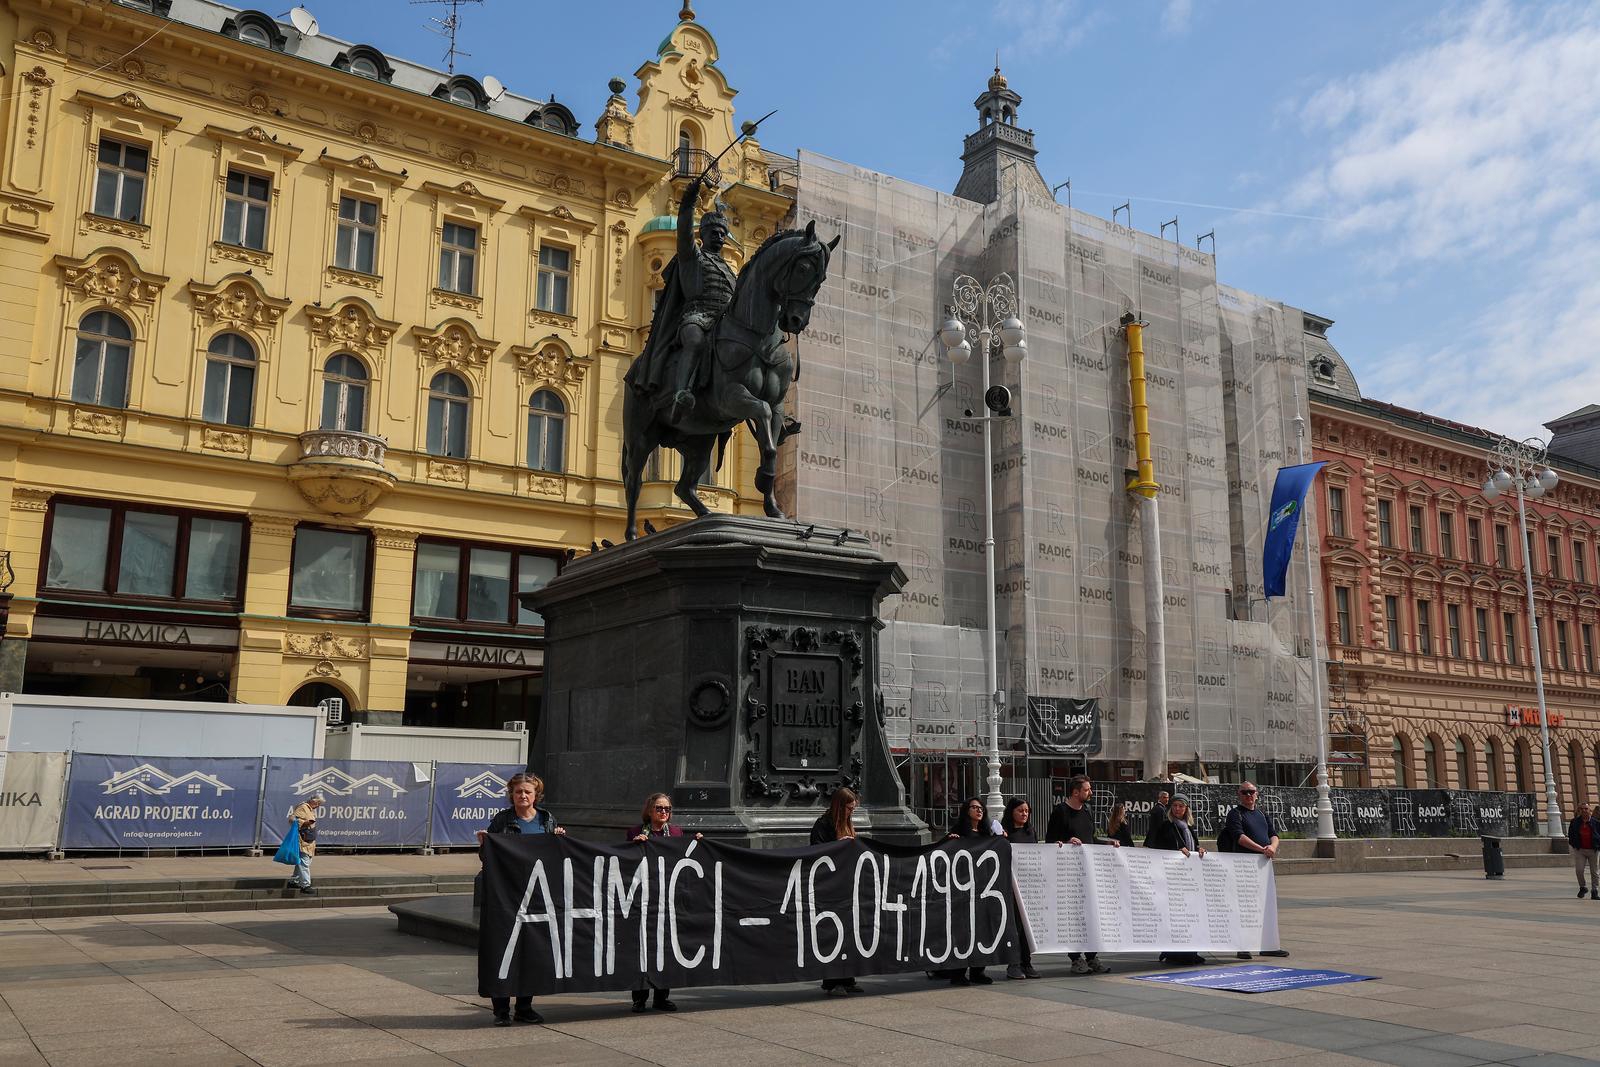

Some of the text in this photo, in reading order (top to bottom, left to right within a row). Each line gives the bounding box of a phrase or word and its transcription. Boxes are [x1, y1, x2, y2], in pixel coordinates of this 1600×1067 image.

[1143, 266, 1174, 285] RADIĆ
[850, 281, 889, 300] RADIĆ
[1029, 306, 1064, 326] RADIĆ
[1072, 353, 1104, 372] RADIĆ
[1146, 373, 1175, 390] RADIĆ
[853, 403, 890, 420] RADIĆ
[946, 419, 982, 435] RADIĆ
[1034, 421, 1068, 439] RADIĆ
[800, 452, 840, 469] RADIĆ
[1187, 452, 1215, 468] RADIĆ
[902, 467, 938, 484] RADIĆ
[1078, 468, 1108, 485] RADIĆ
[1159, 482, 1180, 497] ADIĆ
[857, 530, 893, 548] ADIĆ
[949, 538, 985, 555] RADIĆ
[1039, 543, 1071, 559] RADIĆ
[1119, 549, 1143, 566] RADI
[1192, 562, 1220, 576] RADIĆ
[902, 591, 939, 608] RADIĆ
[1080, 586, 1113, 603] RADIĆ
[1163, 595, 1187, 608] ADIĆ
[85, 622, 192, 645] HARMICA
[445, 645, 527, 665] HARMICA
[787, 669, 825, 692] BAN
[1041, 668, 1074, 682] RADIĆ
[1122, 669, 1145, 681] RADI
[1197, 674, 1225, 687] RADIĆ
[1267, 690, 1293, 703] RADIĆ
[885, 703, 906, 718] DIĆ
[1065, 711, 1092, 724] RADIĆ
[1167, 707, 1190, 721] ADIĆ
[1523, 707, 1564, 727] Müler
[917, 722, 955, 735] RADIĆ
[1268, 719, 1295, 732] RADIĆ
[0, 792, 42, 807] IKA
[1126, 801, 1157, 813] RADI
[94, 805, 233, 822] AGRAD PROJEKT d.o.o.
[329, 806, 376, 821] PROJEKT
[379, 807, 407, 820] d.o.o.
[452, 807, 485, 820] AGRAD
[1291, 804, 1318, 818] RADIĆ
[1358, 804, 1384, 818] RADIĆ
[1418, 803, 1445, 817] RADIĆ
[1480, 805, 1503, 819] RADIĆ
[123, 830, 202, 839] info@agradprojekt.hr
[498, 839, 723, 979] AHMIĆI
[780, 850, 1011, 968] 16.04.1993.
